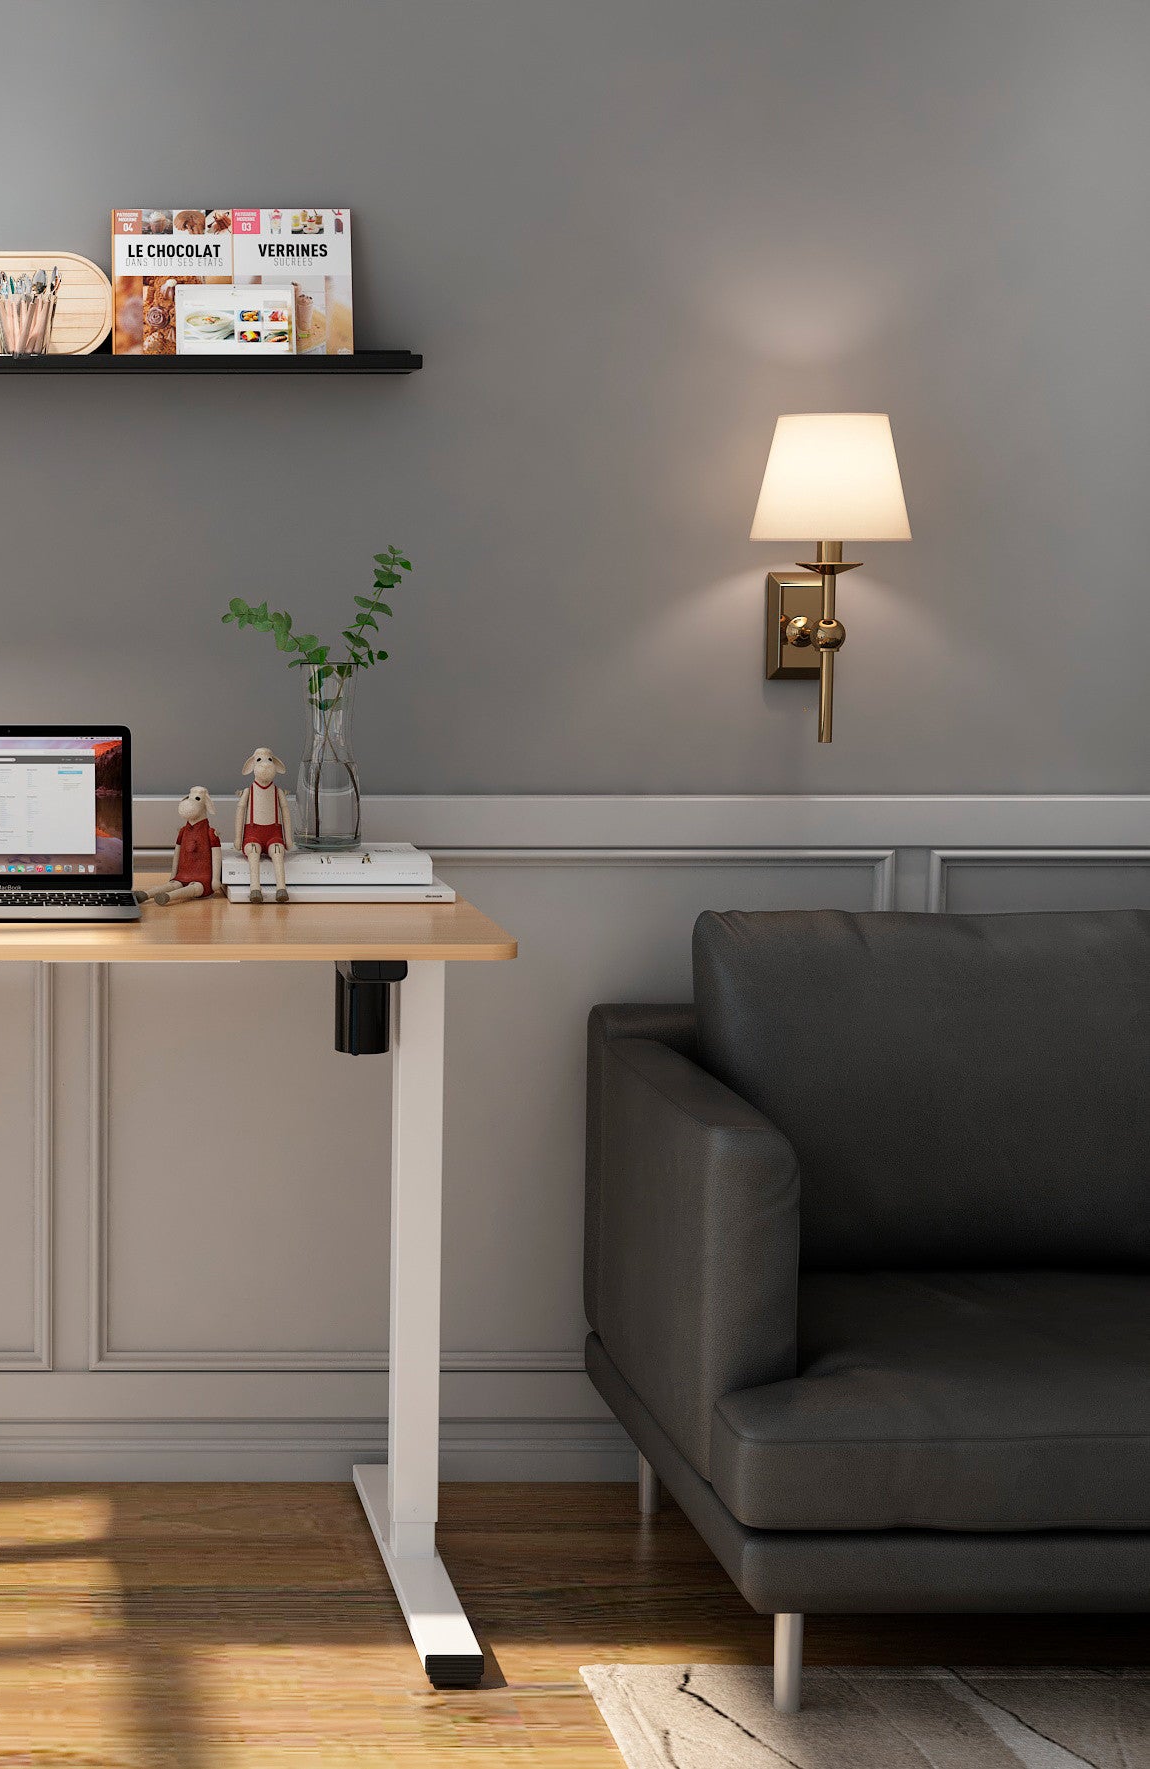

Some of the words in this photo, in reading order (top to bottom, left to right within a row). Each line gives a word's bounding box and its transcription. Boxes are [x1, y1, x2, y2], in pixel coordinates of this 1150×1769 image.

[123, 222, 134, 232] 04
[241, 221, 252, 232] 03
[128, 244, 144, 258] LE
[147, 244, 221, 258] CHOCOLAT
[258, 243, 328, 258] VERRINES
[125, 257, 148, 267] DANS
[152, 257, 173, 267] TOUT
[177, 257, 194, 267] SES
